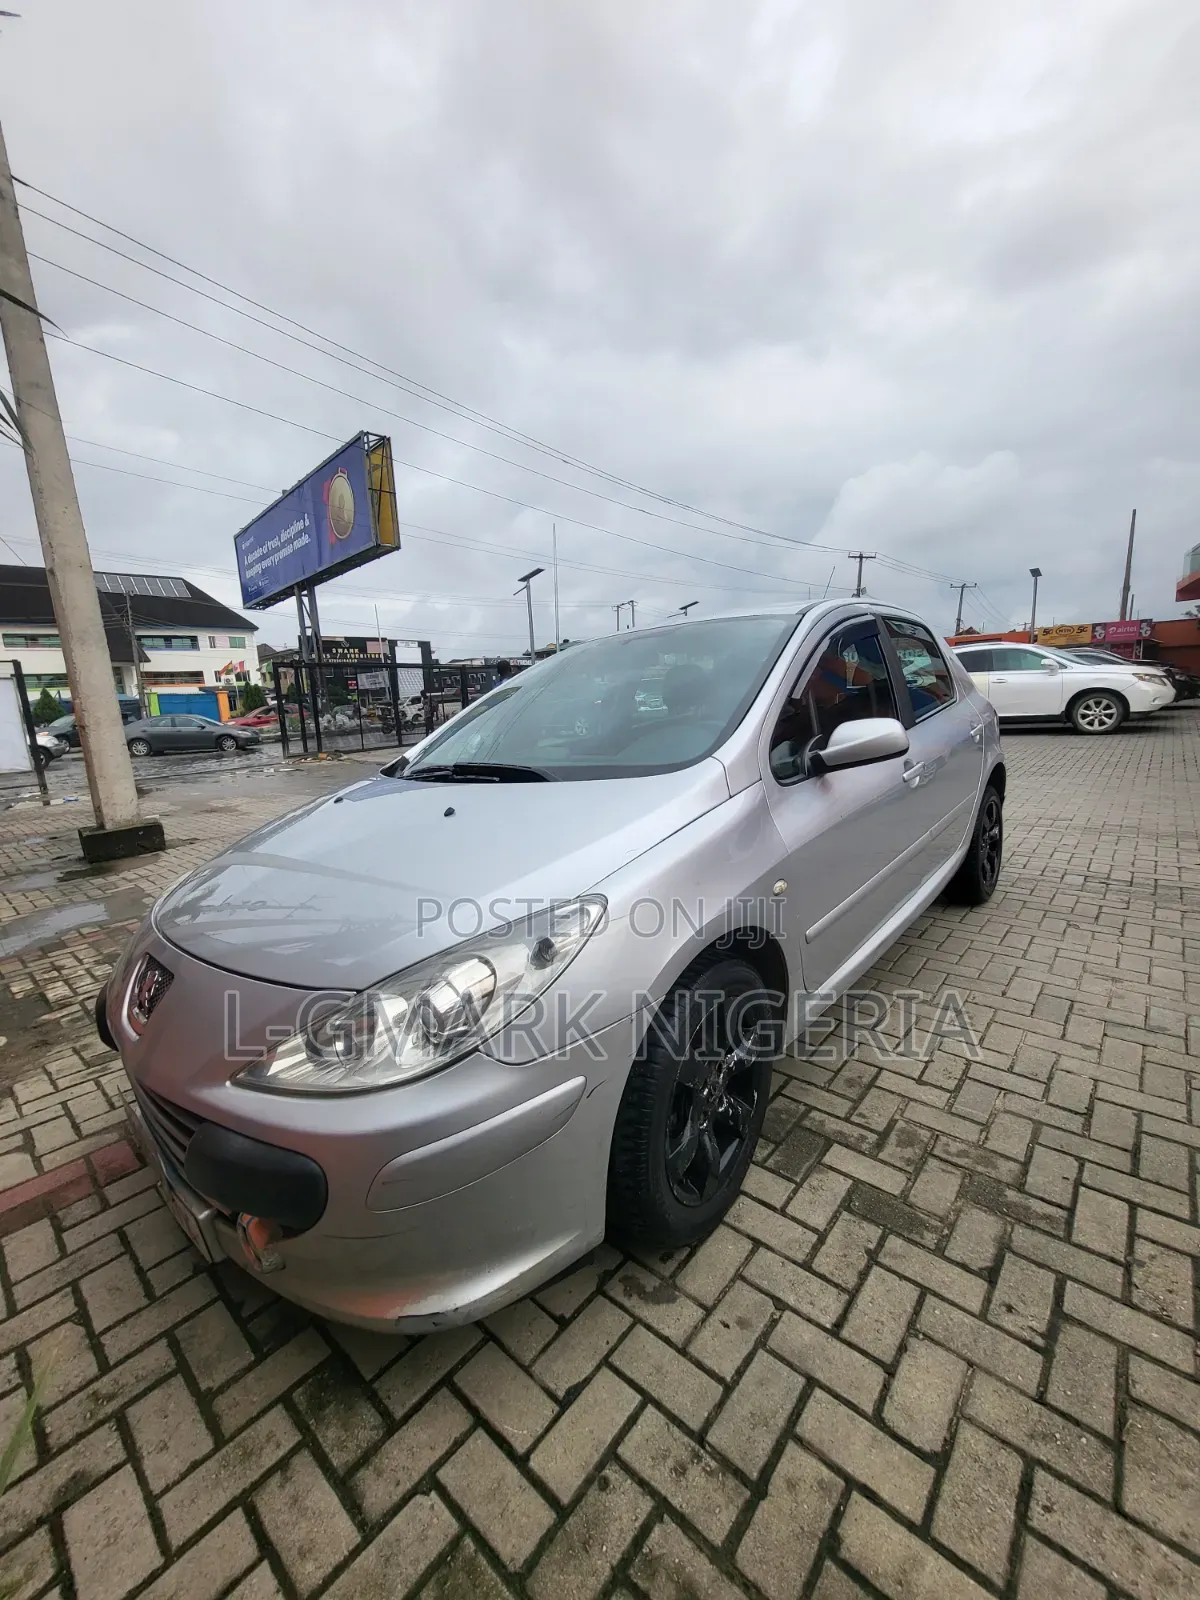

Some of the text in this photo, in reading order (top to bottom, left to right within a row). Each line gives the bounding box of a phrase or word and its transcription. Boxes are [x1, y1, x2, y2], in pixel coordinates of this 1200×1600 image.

[247, 547, 263, 562] decade
[280, 519, 304, 543] discipline
[304, 513, 310, 527] &
[245, 561, 262, 579] keeping
[261, 555, 274, 570] every
[273, 545, 293, 565] promise
[1076, 626, 1089, 634] 5G
